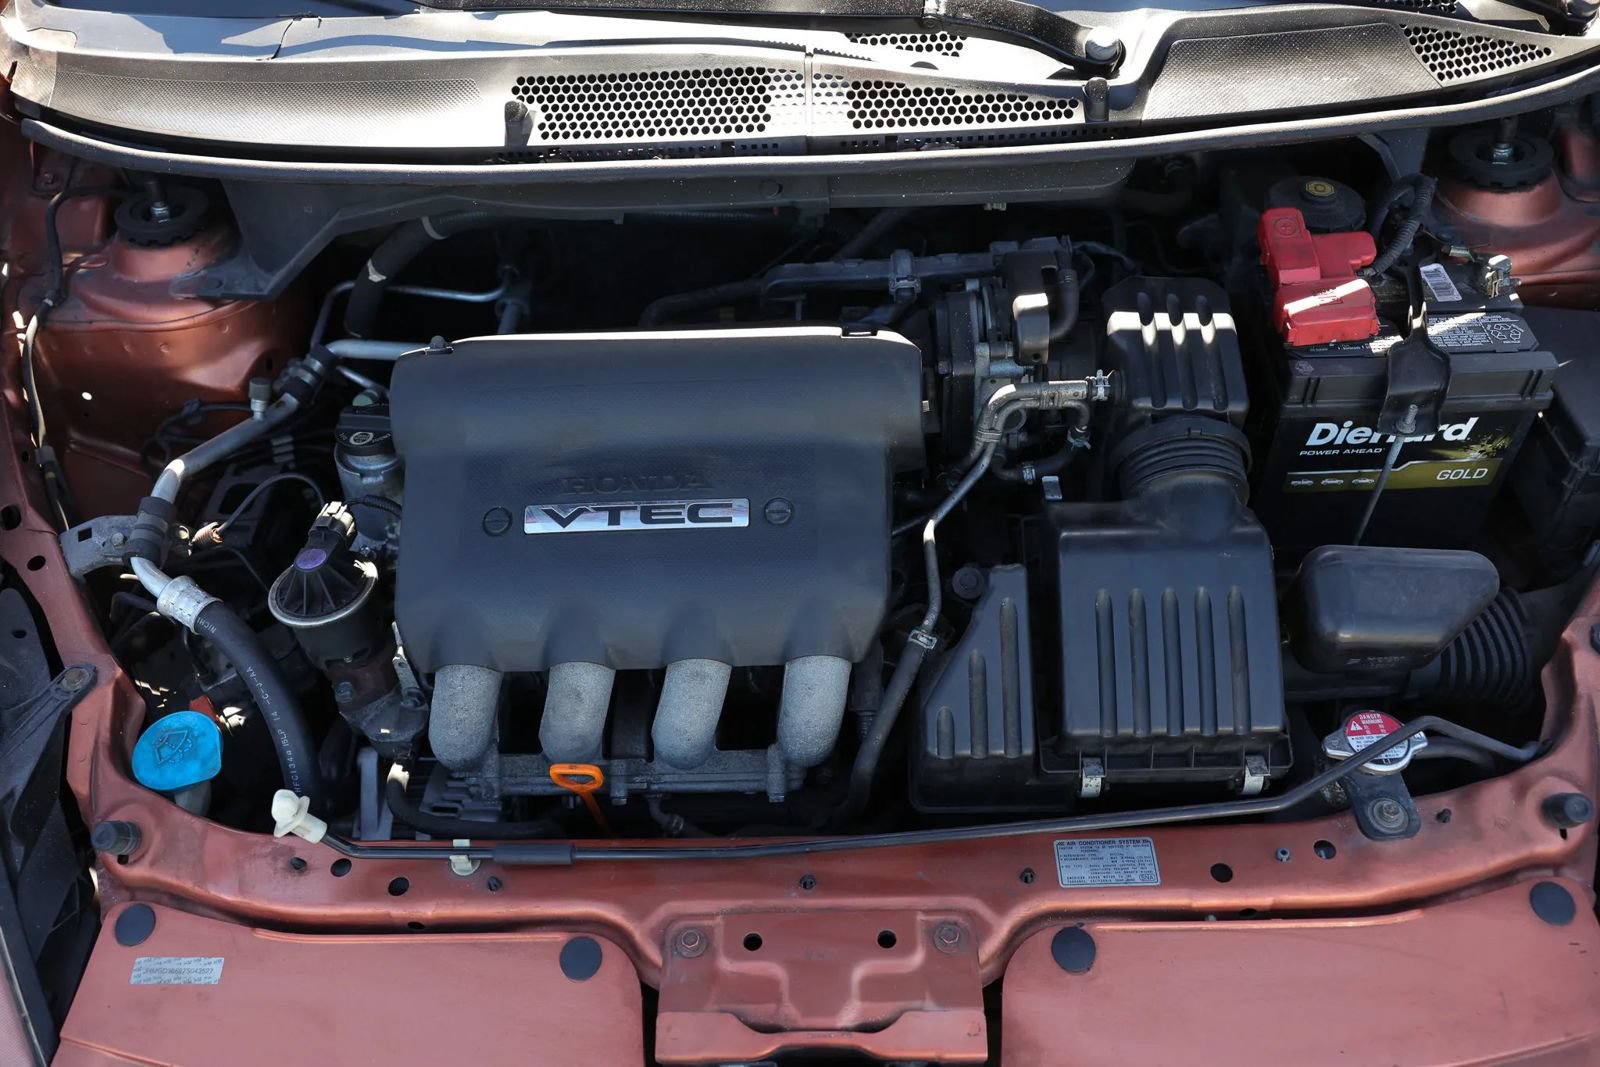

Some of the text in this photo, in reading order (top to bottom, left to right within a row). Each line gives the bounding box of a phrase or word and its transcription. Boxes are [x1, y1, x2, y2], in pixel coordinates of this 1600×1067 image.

[561, 473, 713, 494] HONDA
[1436, 467, 1489, 481] GOLD
[541, 502, 734, 529] VTEC
